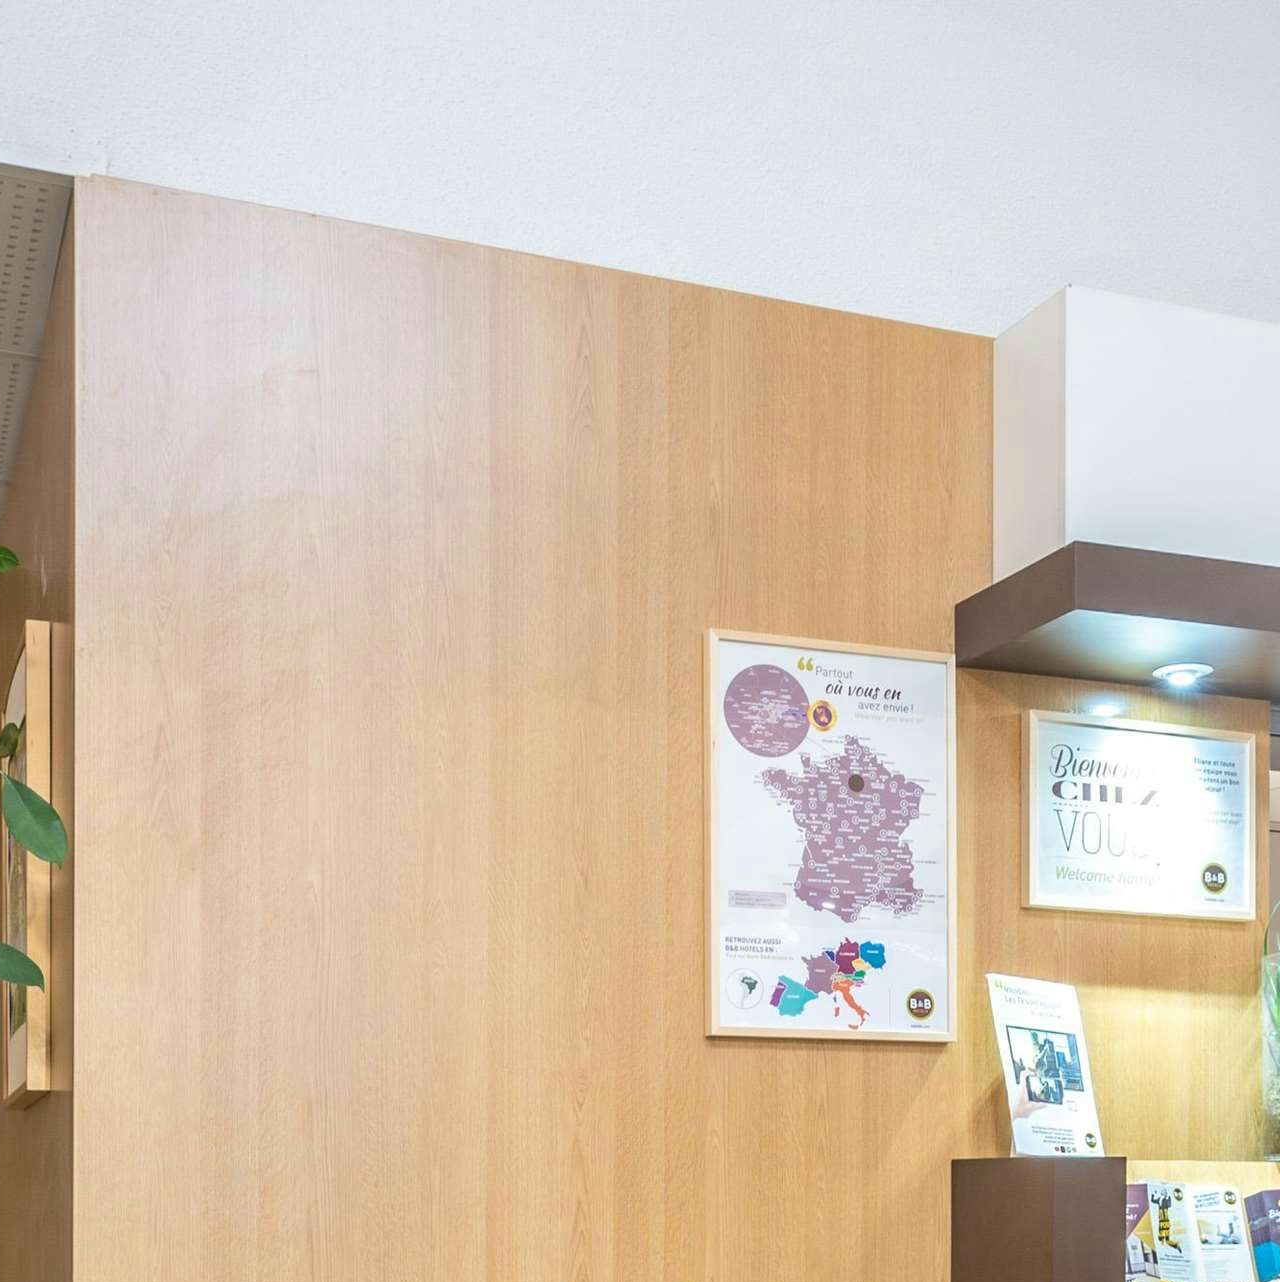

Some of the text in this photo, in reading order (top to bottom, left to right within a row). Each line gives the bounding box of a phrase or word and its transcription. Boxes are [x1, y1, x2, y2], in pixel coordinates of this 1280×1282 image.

[815, 665, 853, 680] Partout
[825, 680, 902, 700] où vous en
[858, 702, 880, 712] avez
[1052, 808, 1148, 859] VOU
[1055, 865, 1114, 884] Welcome
